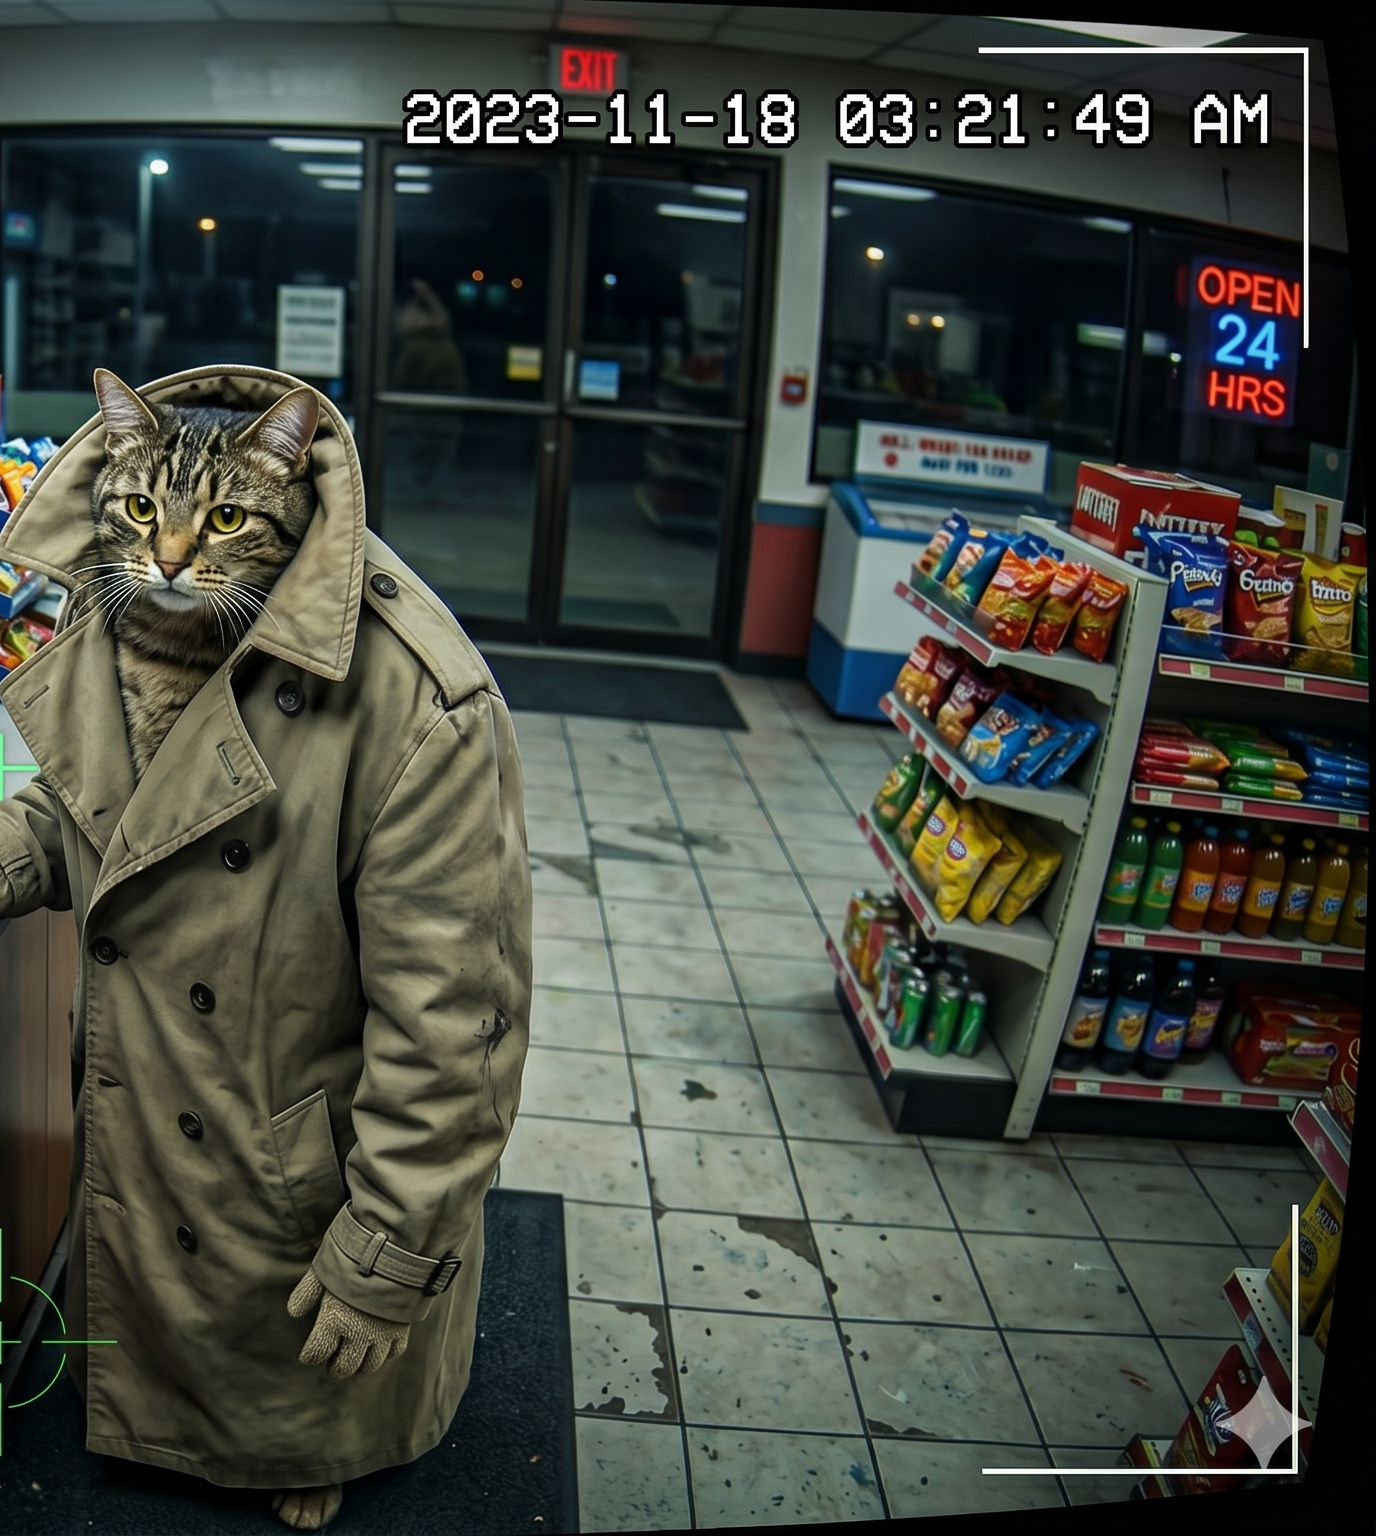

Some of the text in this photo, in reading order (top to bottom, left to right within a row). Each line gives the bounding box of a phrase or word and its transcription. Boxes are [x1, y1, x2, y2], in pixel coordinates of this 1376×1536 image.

[561, 46, 617, 91] EXIT
[1197, 265, 1301, 318] OPEN
[1215, 313, 1280, 371] 24
[1208, 370, 1286, 417] HRS
